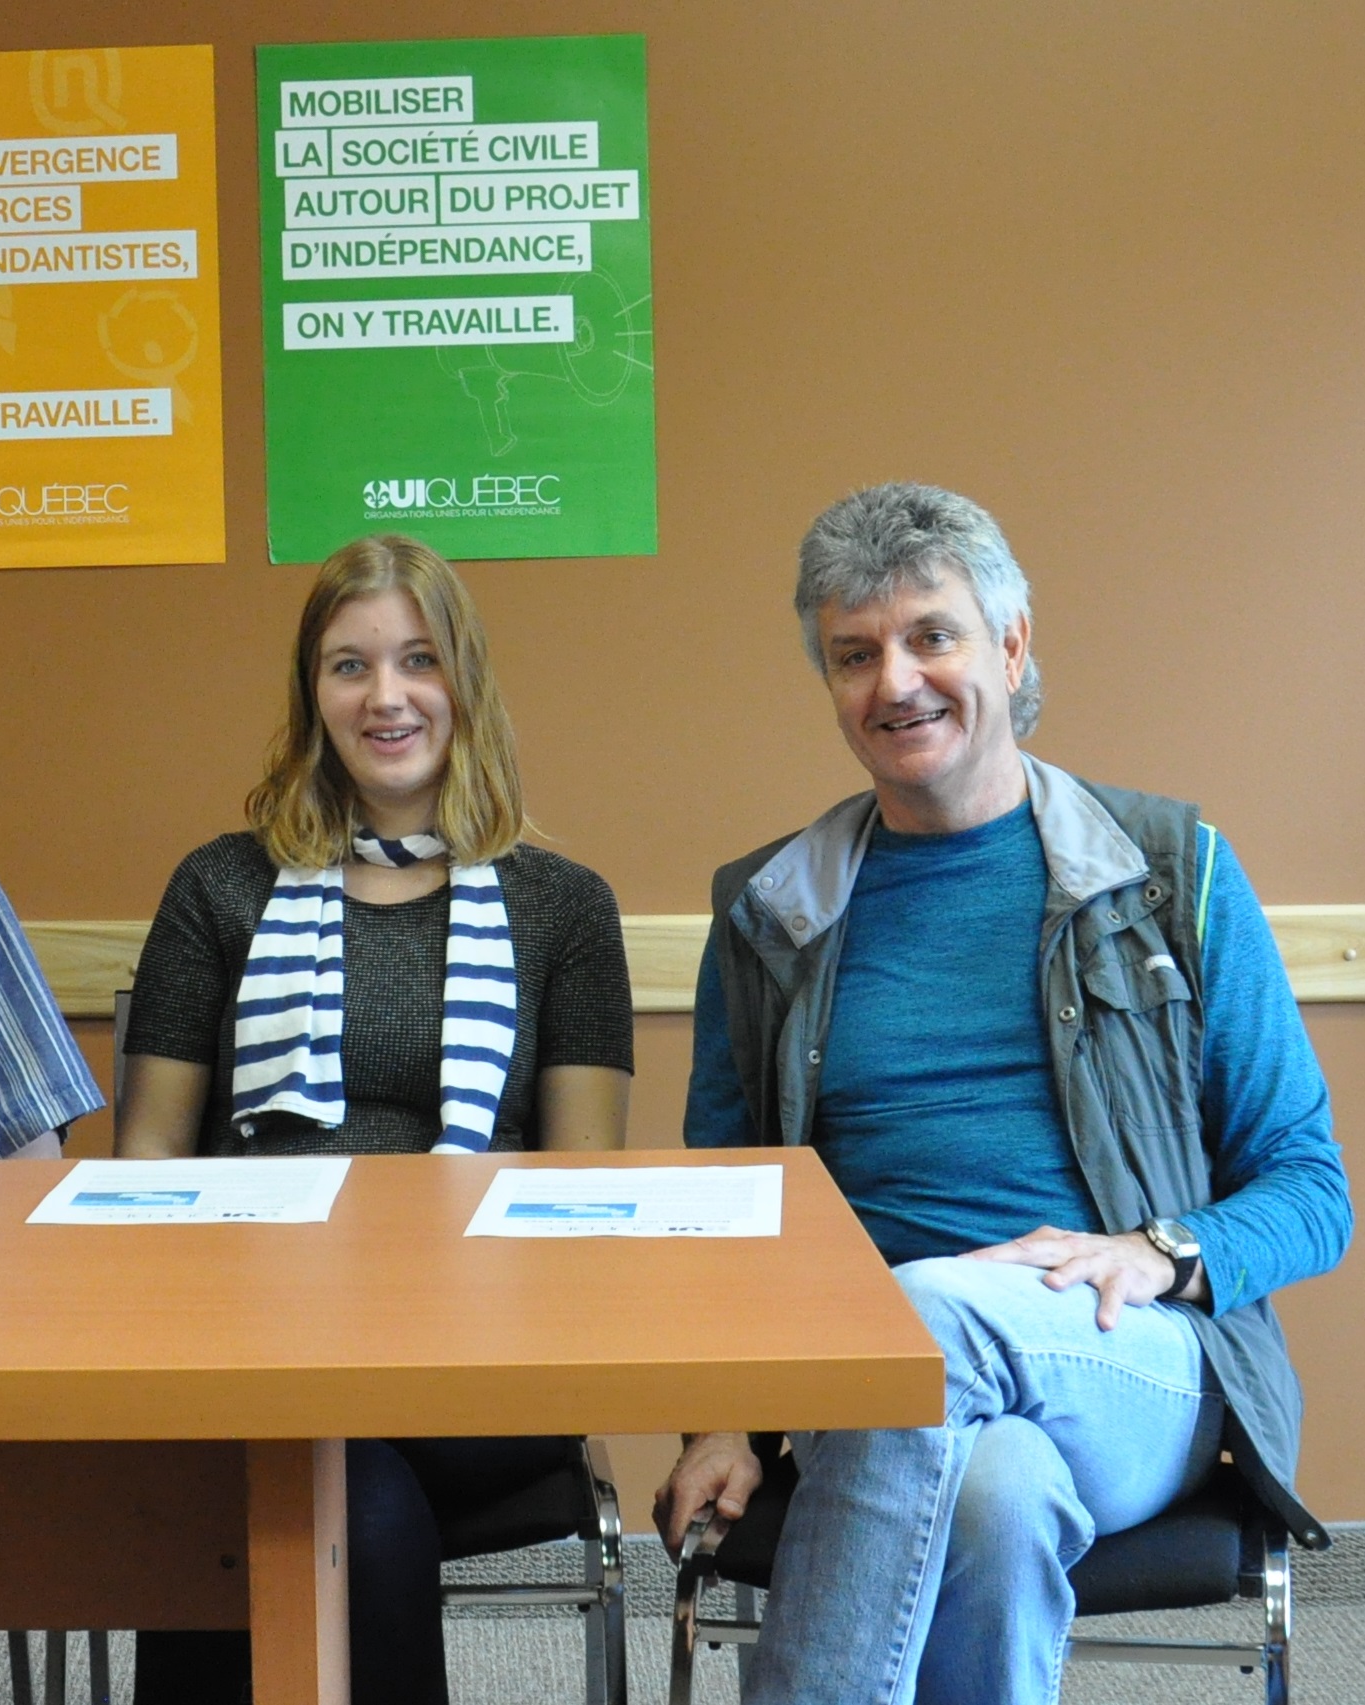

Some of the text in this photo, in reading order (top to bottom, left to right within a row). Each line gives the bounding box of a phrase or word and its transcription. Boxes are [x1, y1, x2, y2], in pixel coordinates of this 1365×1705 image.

[289, 86, 464, 118] MOBILISER
[282, 130, 589, 168] LA SOCIÉTÉ CIVILE
[293, 182, 631, 217] AUTOUR DU PROJET
[290, 232, 585, 269] D'INDÉPENDANCE,
[297, 306, 560, 339] ON Y TRAVAILLE.
[31, 516, 56, 526] POUR
[364, 509, 434, 520] ORGANISATIONS
[435, 508, 461, 518] UNIES
[462, 507, 487, 517] POUR
